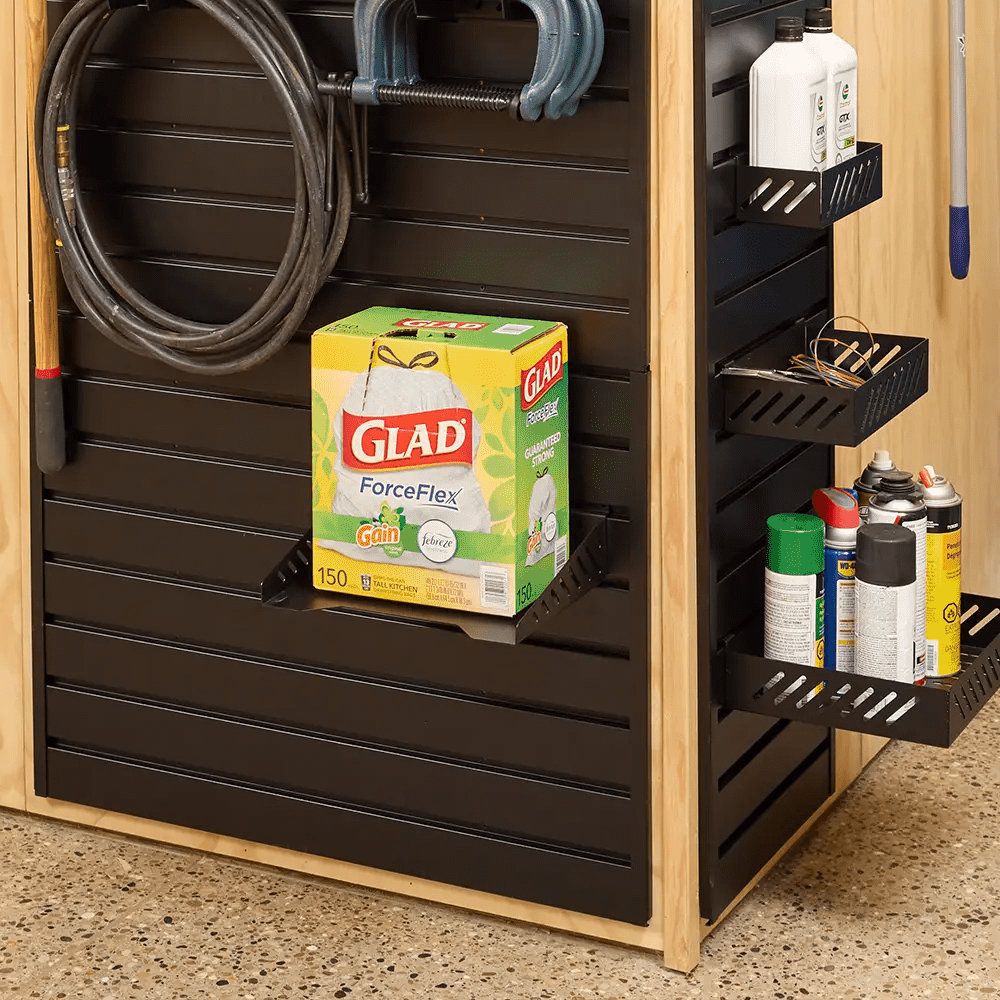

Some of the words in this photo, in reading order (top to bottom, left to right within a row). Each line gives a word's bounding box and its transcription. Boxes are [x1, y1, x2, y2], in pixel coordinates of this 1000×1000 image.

[839, 112, 851, 123] GTX
[402, 319, 480, 330] GLAD
[524, 349, 562, 402] GLAD
[525, 396, 560, 428] ForceFlex
[351, 419, 466, 464] GLAD
[524, 431, 561, 460] GUARANTEED
[531, 446, 555, 468] STRONG
[359, 476, 463, 506] ForceFlex
[356, 523, 400, 548] Gain
[421, 532, 453, 549] febreze
[317, 567, 348, 588] 150
[373, 580, 388, 589] TALL
[388, 582, 418, 593] KITCHEN
[516, 581, 533, 606] 150
